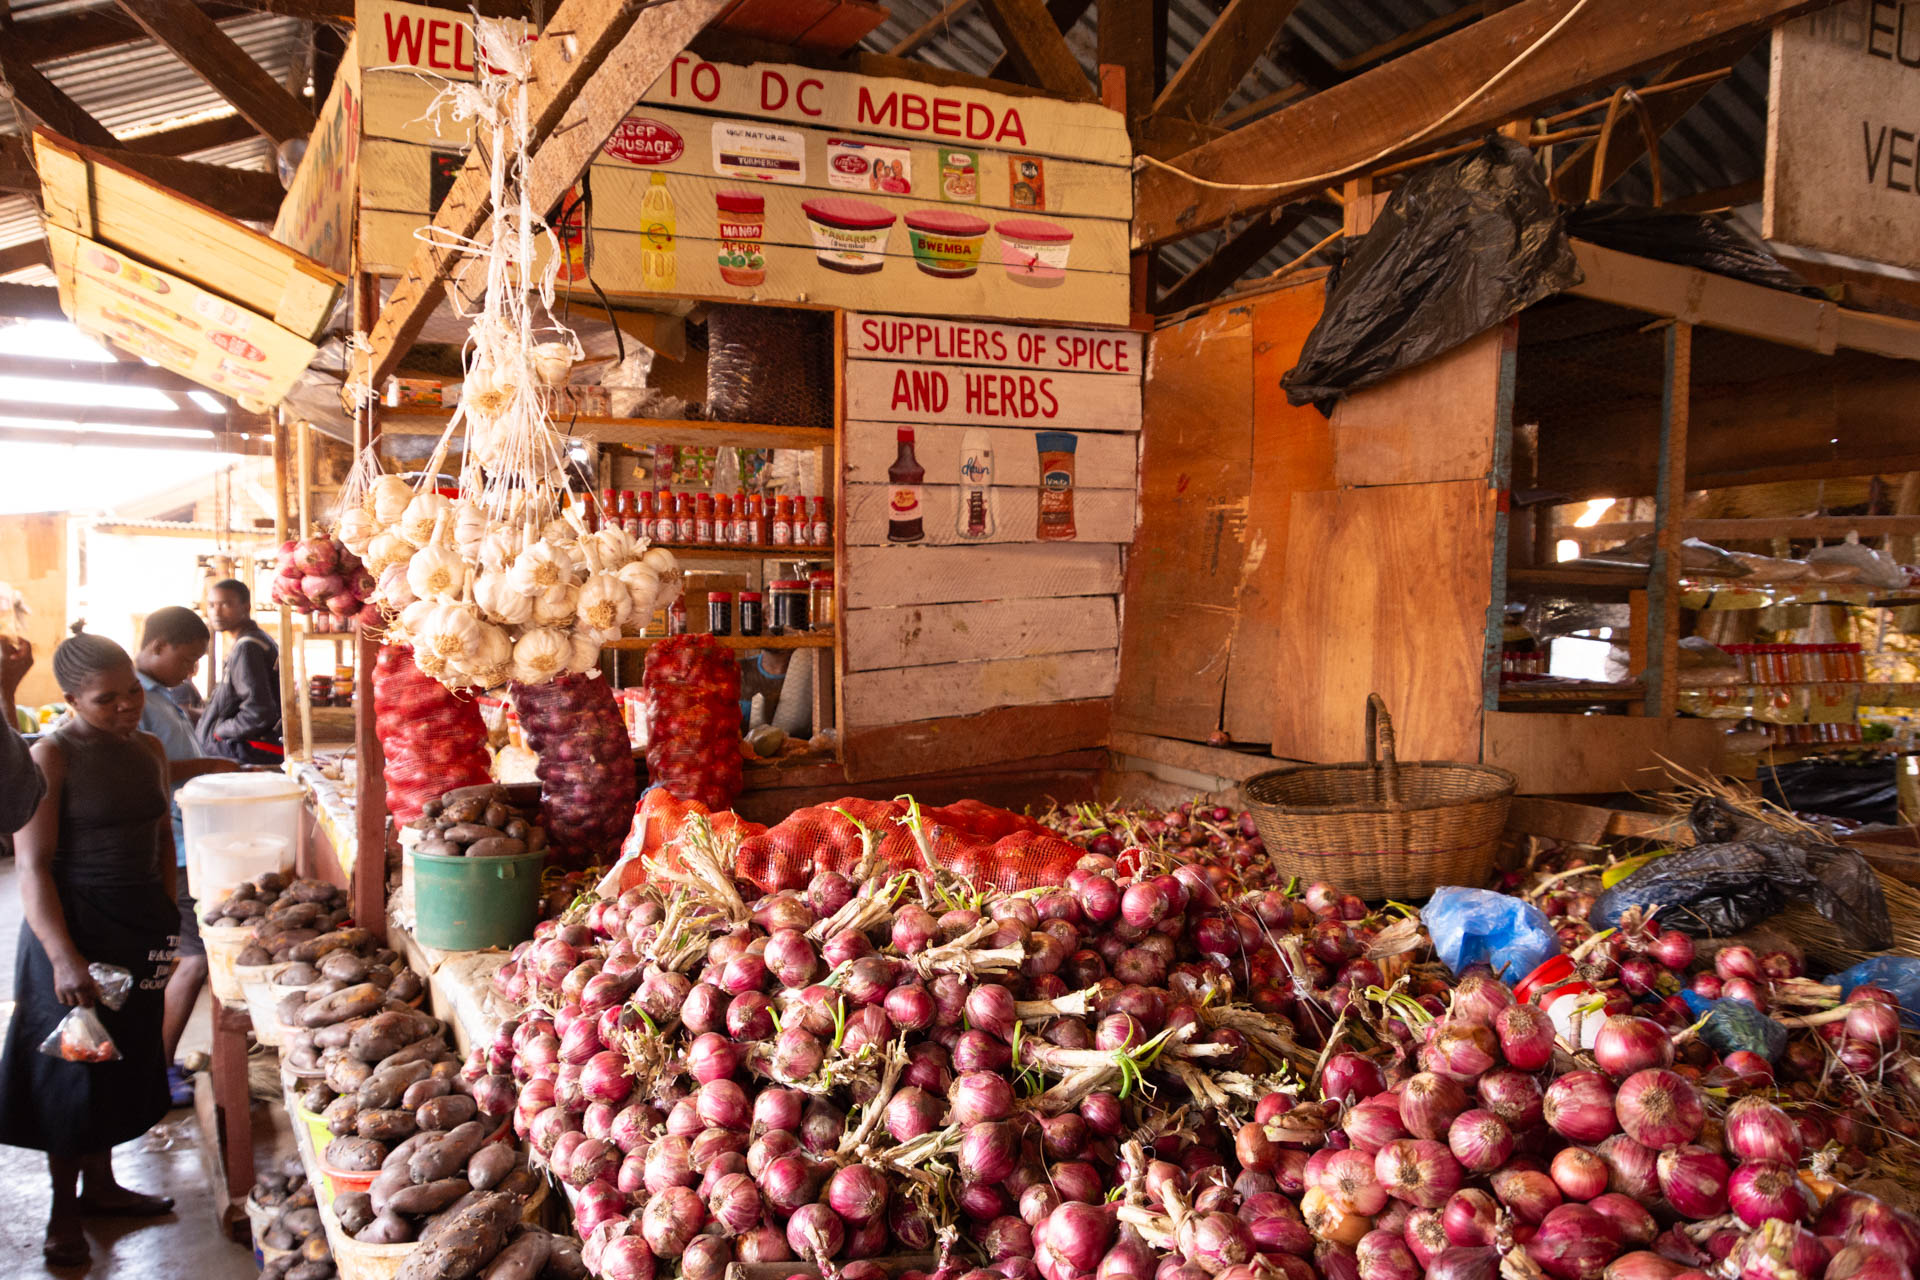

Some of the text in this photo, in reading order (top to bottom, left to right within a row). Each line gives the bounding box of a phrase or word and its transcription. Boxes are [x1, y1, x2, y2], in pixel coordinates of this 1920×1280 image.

[670, 56, 721, 103] TO
[760, 70, 825, 117] DC
[857, 87, 1027, 146] MBEDA
[608, 136, 674, 154] SAUSAGE
[918, 238, 972, 254] BWEMBA
[862, 319, 1130, 372] SUPPLIERS OF SPICE
[891, 369, 1059, 419] AND HERBS
